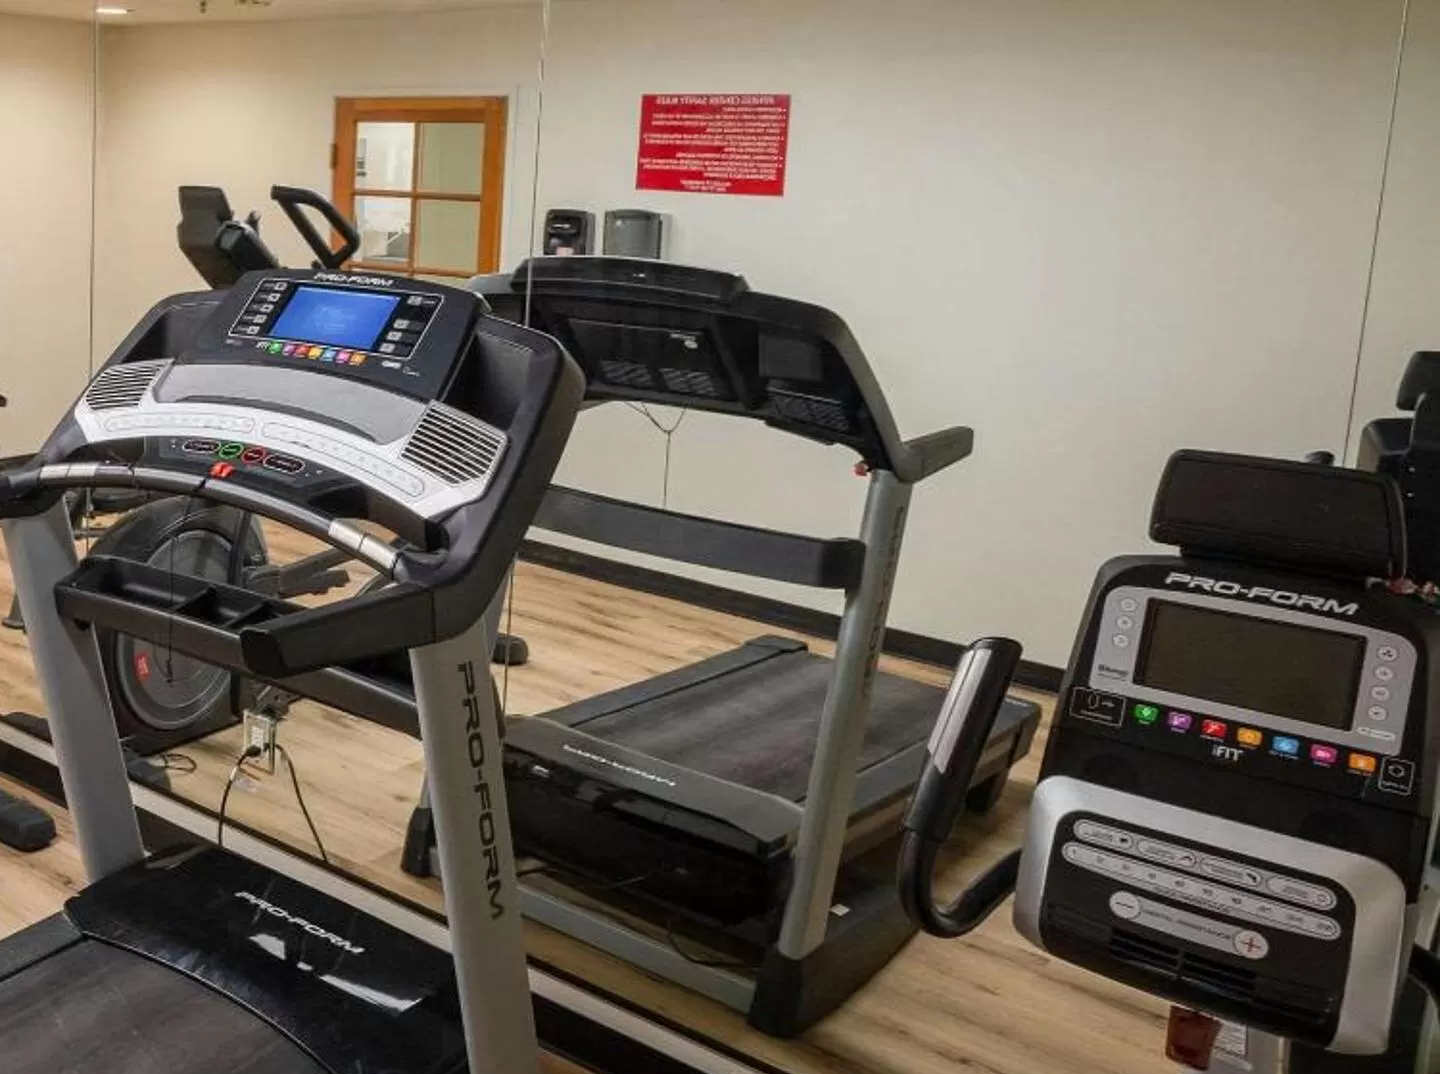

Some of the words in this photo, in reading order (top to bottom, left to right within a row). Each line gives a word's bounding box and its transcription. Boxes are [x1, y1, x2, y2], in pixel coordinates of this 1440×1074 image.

[314, 272, 394, 287] PRO-FORM
[1165, 572, 1359, 616] PRO-FORM
[457, 659, 505, 920] PRO-FORM
